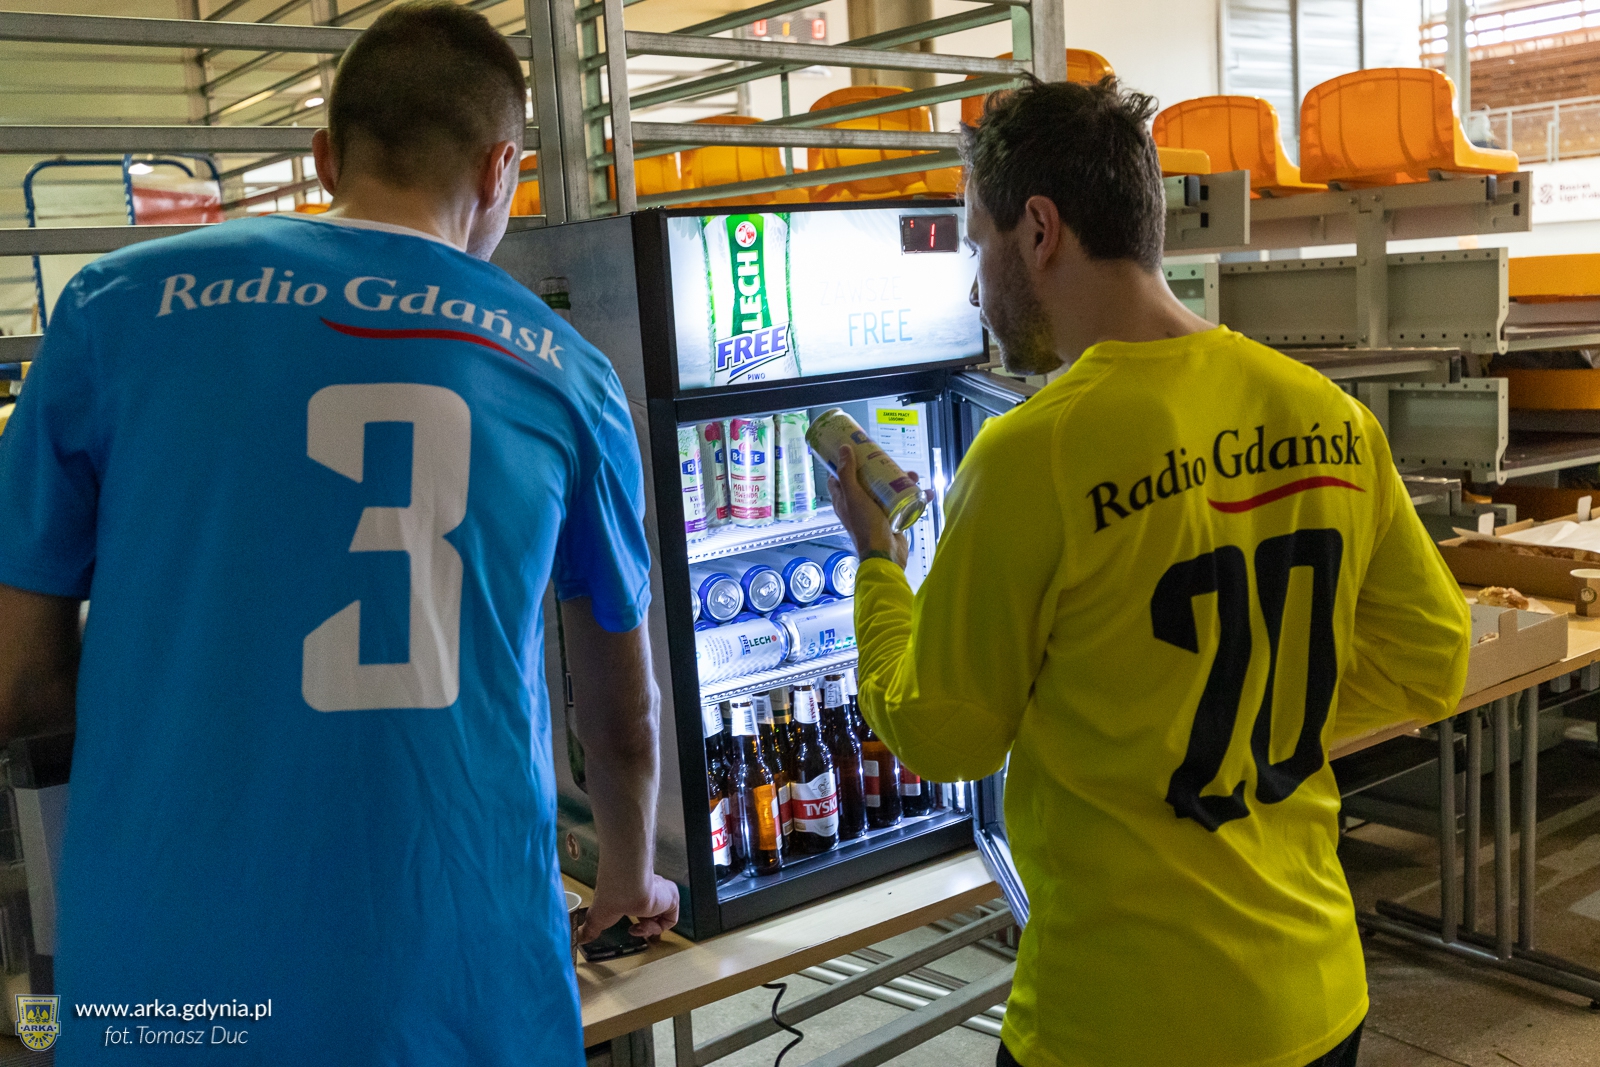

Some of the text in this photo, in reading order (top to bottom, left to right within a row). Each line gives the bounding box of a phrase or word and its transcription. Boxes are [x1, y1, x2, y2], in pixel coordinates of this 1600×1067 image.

[930, 222, 936, 248] 1
[738, 250, 763, 332] LECH
[819, 275, 903, 306] ZAWSZE
[156, 268, 565, 371] Radio Gdańsk
[848, 308, 912, 346] FREE
[715, 325, 788, 367] FREE
[747, 373, 765, 381] PIWO
[1086, 421, 1363, 533] Radio Gdańsk
[302, 382, 471, 712] 3
[740, 635, 752, 655] FREE
[749, 635, 772, 647] LECH
[1151, 527, 1343, 833] 20
